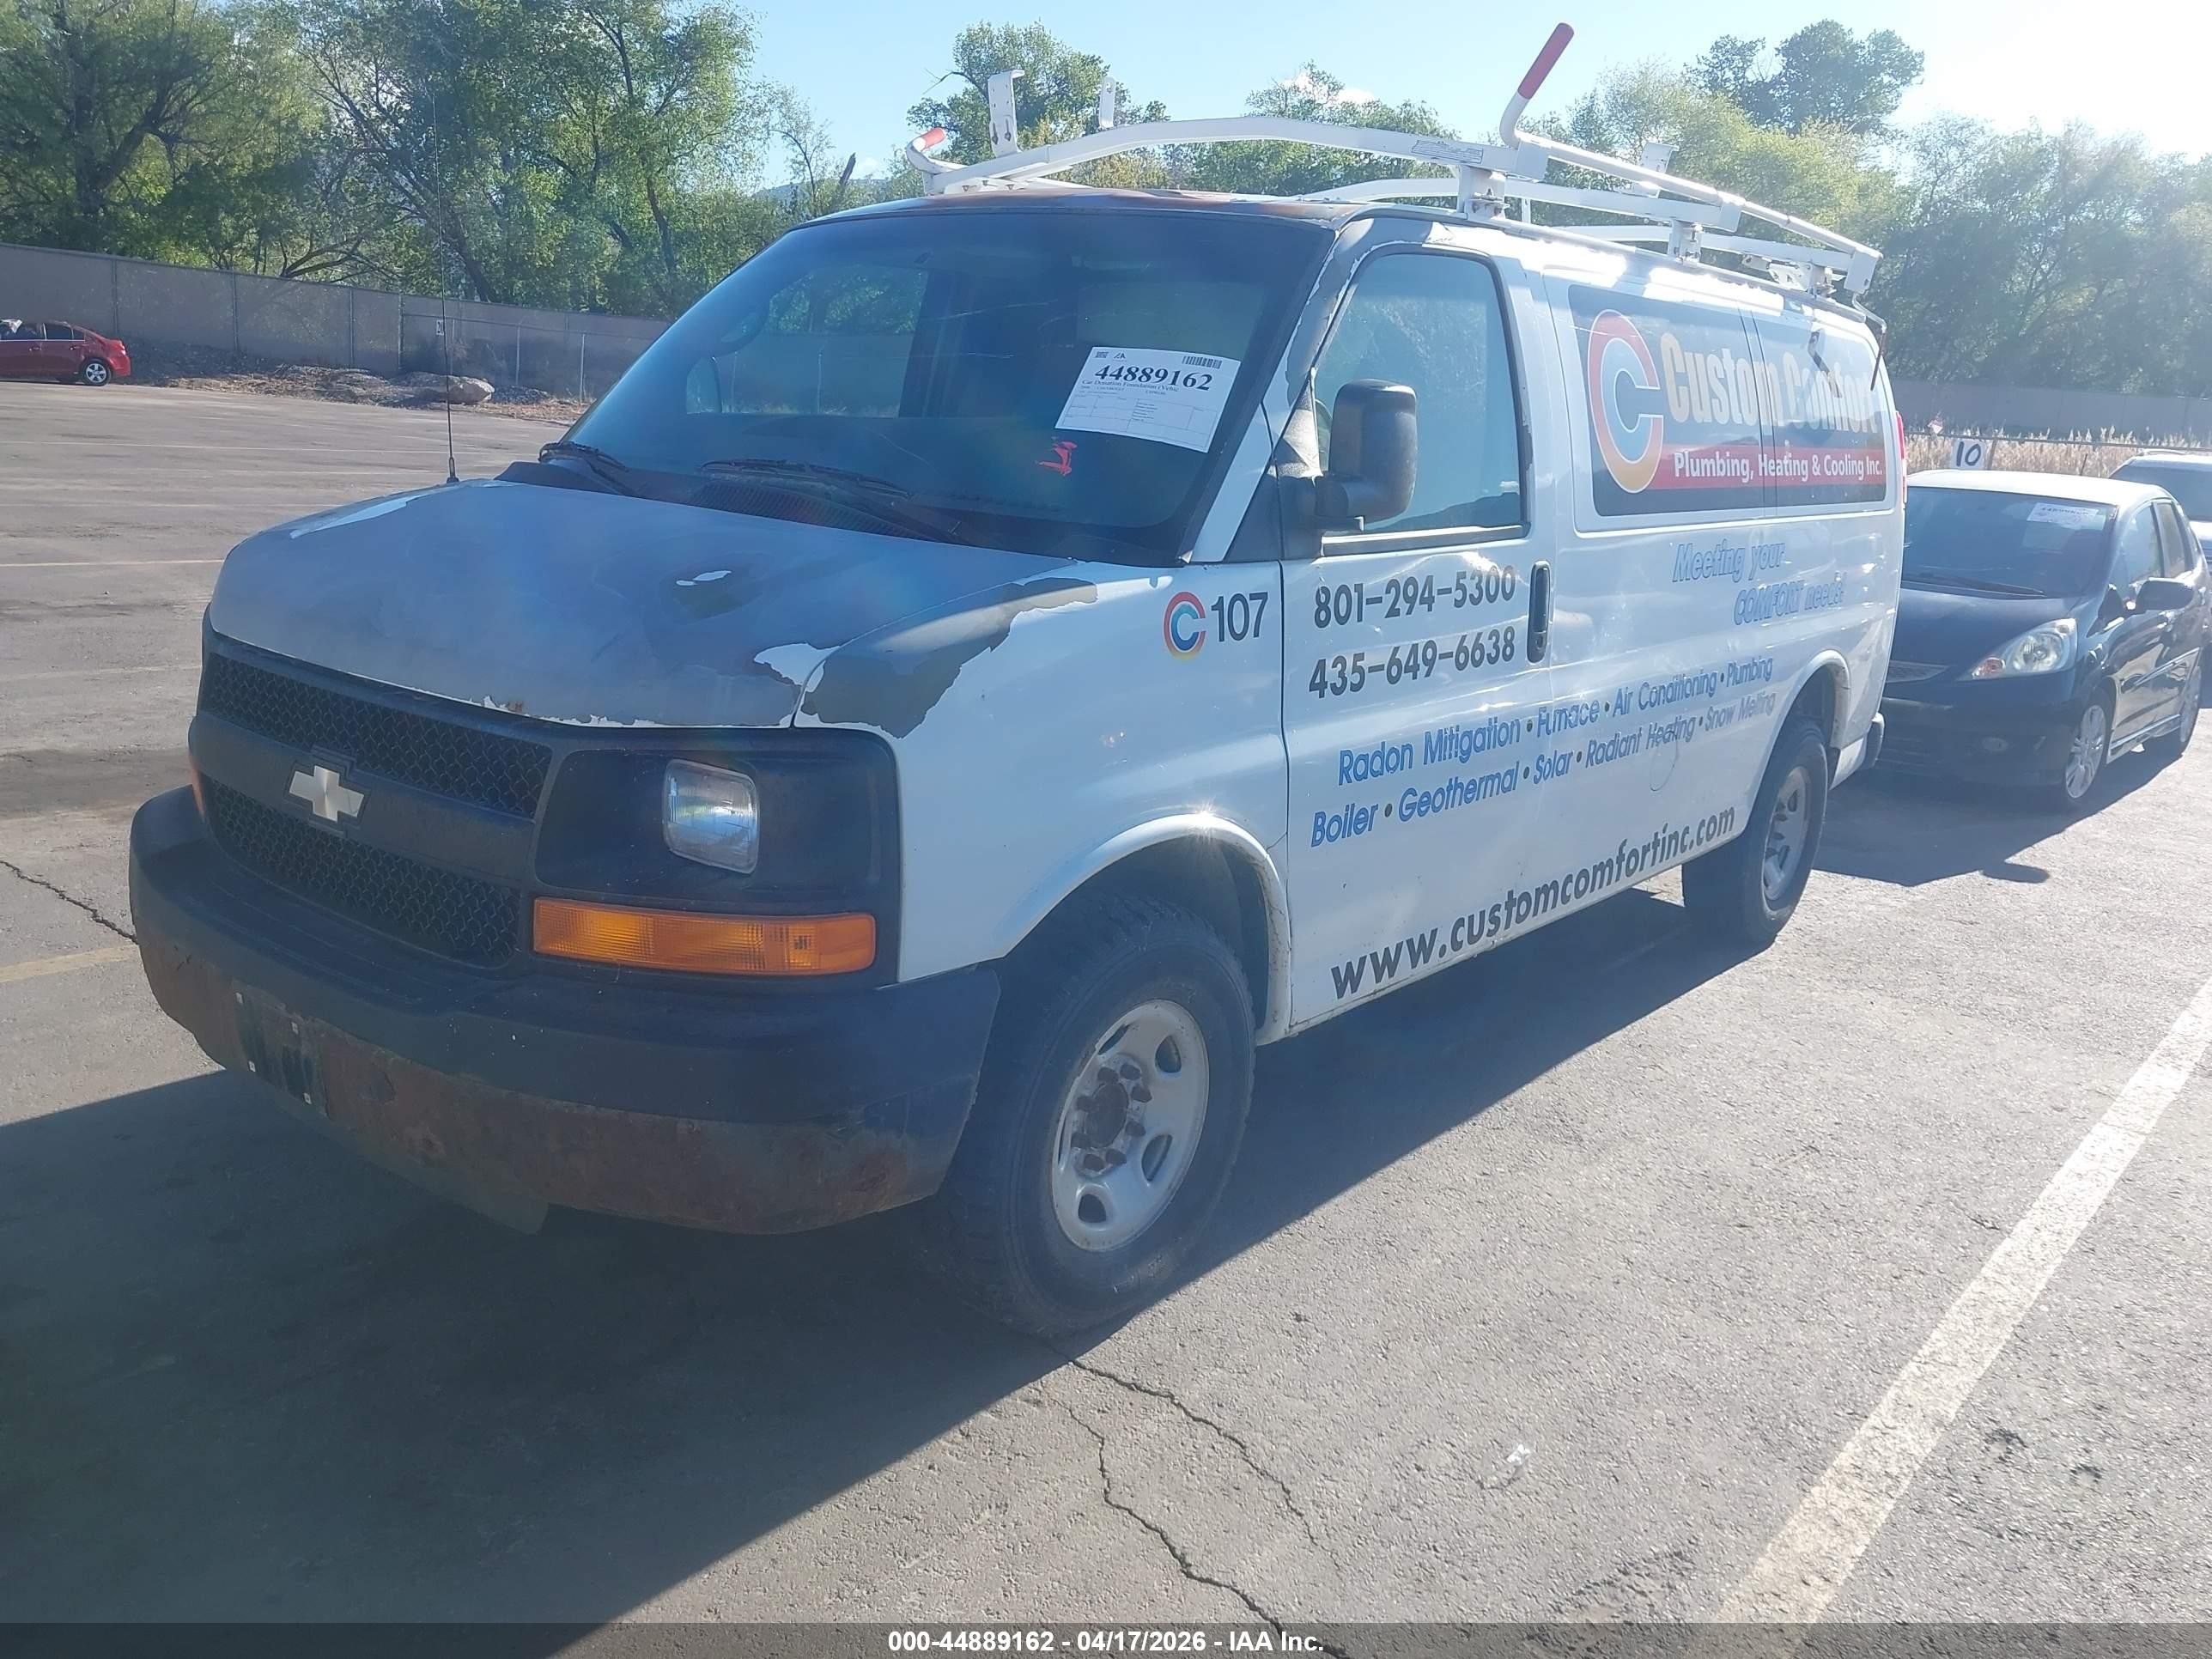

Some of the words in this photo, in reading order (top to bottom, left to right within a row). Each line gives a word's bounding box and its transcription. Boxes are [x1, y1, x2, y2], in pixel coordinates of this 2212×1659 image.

[1095, 364, 1213, 392] 44889162
[1661, 332, 1784, 428] Custom
[1674, 452, 1754, 483] Plumbing,
[1758, 453, 1808, 483] Heating
[1812, 454, 1821, 477] &
[1824, 454, 1864, 481] Cooling
[1866, 455, 1883, 476] Inc.
[1955, 441, 1982, 467] 10
[1672, 538, 1746, 583] Meeting
[1748, 543, 1786, 582] your
[1211, 591, 1269, 642] 107
[1314, 565, 1516, 629] 801-294-5300
[1733, 580, 1805, 626] COMFORT
[1309, 626, 1516, 699] 435-649-6638
[1338, 741, 1413, 787] Radon
[1423, 716, 1521, 764] Mitigation
[1536, 699, 1601, 738] Furnace
[1612, 687, 1633, 718] Air
[1638, 669, 1718, 711] Conditioning
[1726, 655, 1773, 688] Plumbing
[1310, 803, 1379, 848] Boiler
[1398, 761, 1520, 823] Geothermal
[1533, 749, 1574, 785] Solar
[1585, 727, 1644, 769] Radiant
[1645, 714, 1696, 750] Heating
[1705, 706, 1734, 732] Snow
[1737, 690, 1777, 722] Melting
[1330, 804, 1736, 1000] www.customcomfortinc.com
